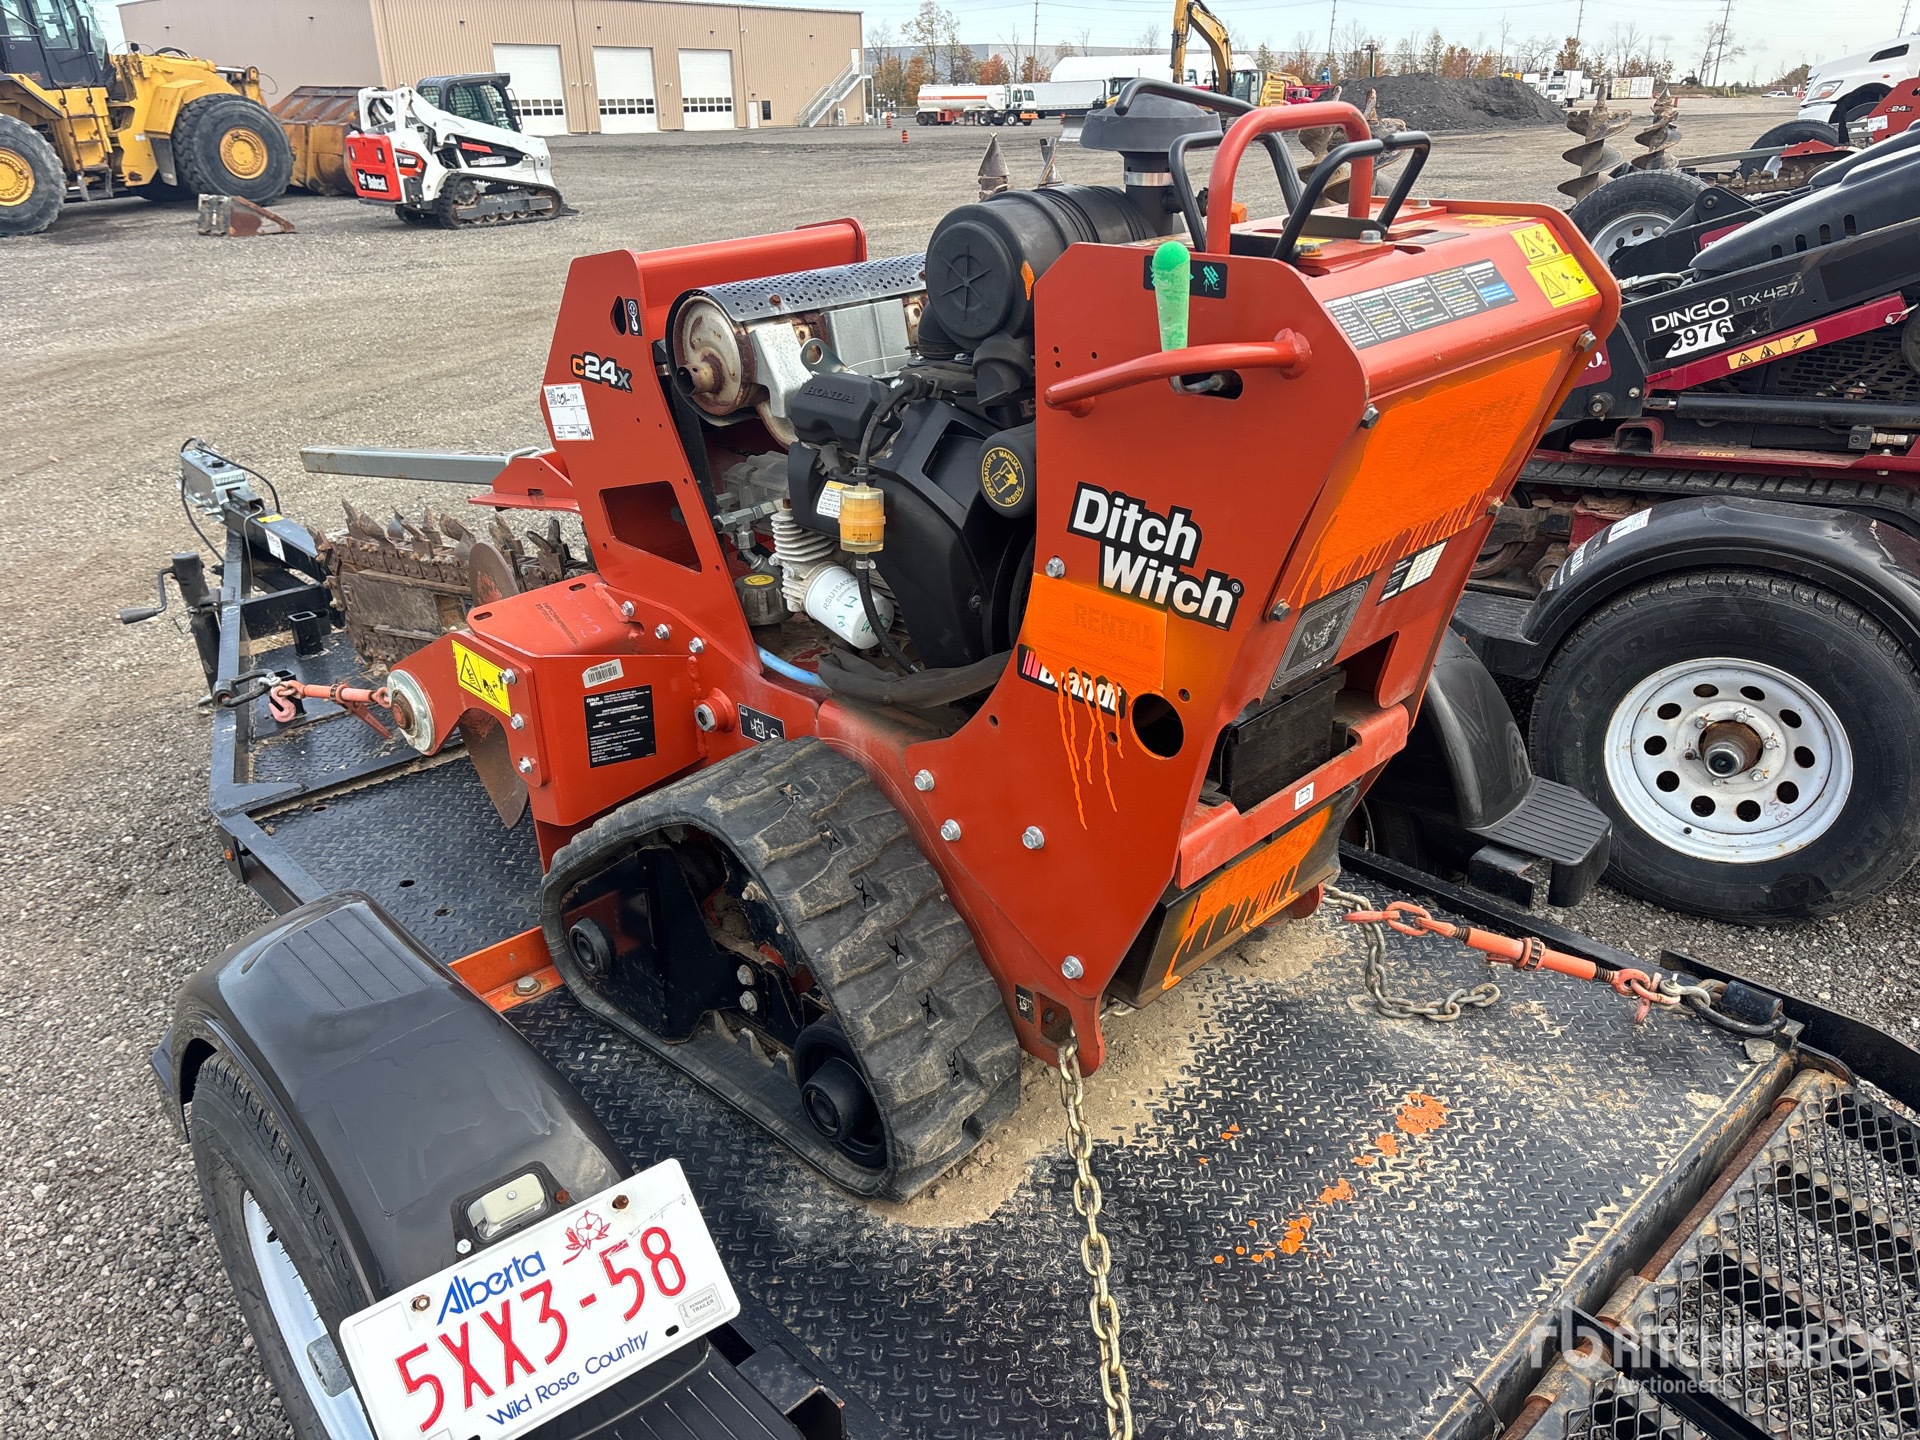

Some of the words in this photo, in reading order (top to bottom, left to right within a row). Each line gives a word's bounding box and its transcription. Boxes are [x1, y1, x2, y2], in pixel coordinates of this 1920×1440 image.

[1651, 297, 1729, 333] DINGO
[805, 386, 855, 404] HONDA
[983, 452, 997, 497] OPERATOR'S
[998, 451, 1021, 472] MANUAL
[1004, 485, 1023, 504] INSIDE
[1072, 488, 1197, 561] Ditch
[1103, 545, 1233, 624] Witch
[1072, 603, 1156, 651] RENTAL
[1579, 617, 1808, 700] CARLISLE
[436, 1250, 546, 1326] Alberta
[690, 1294, 713, 1308] PERMANENT
[692, 1299, 714, 1313] TRAILER
[394, 1226, 686, 1432] 5XX3-58
[486, 1394, 531, 1426] Wild
[535, 1371, 580, 1404] Rose
[585, 1330, 649, 1375] Country
